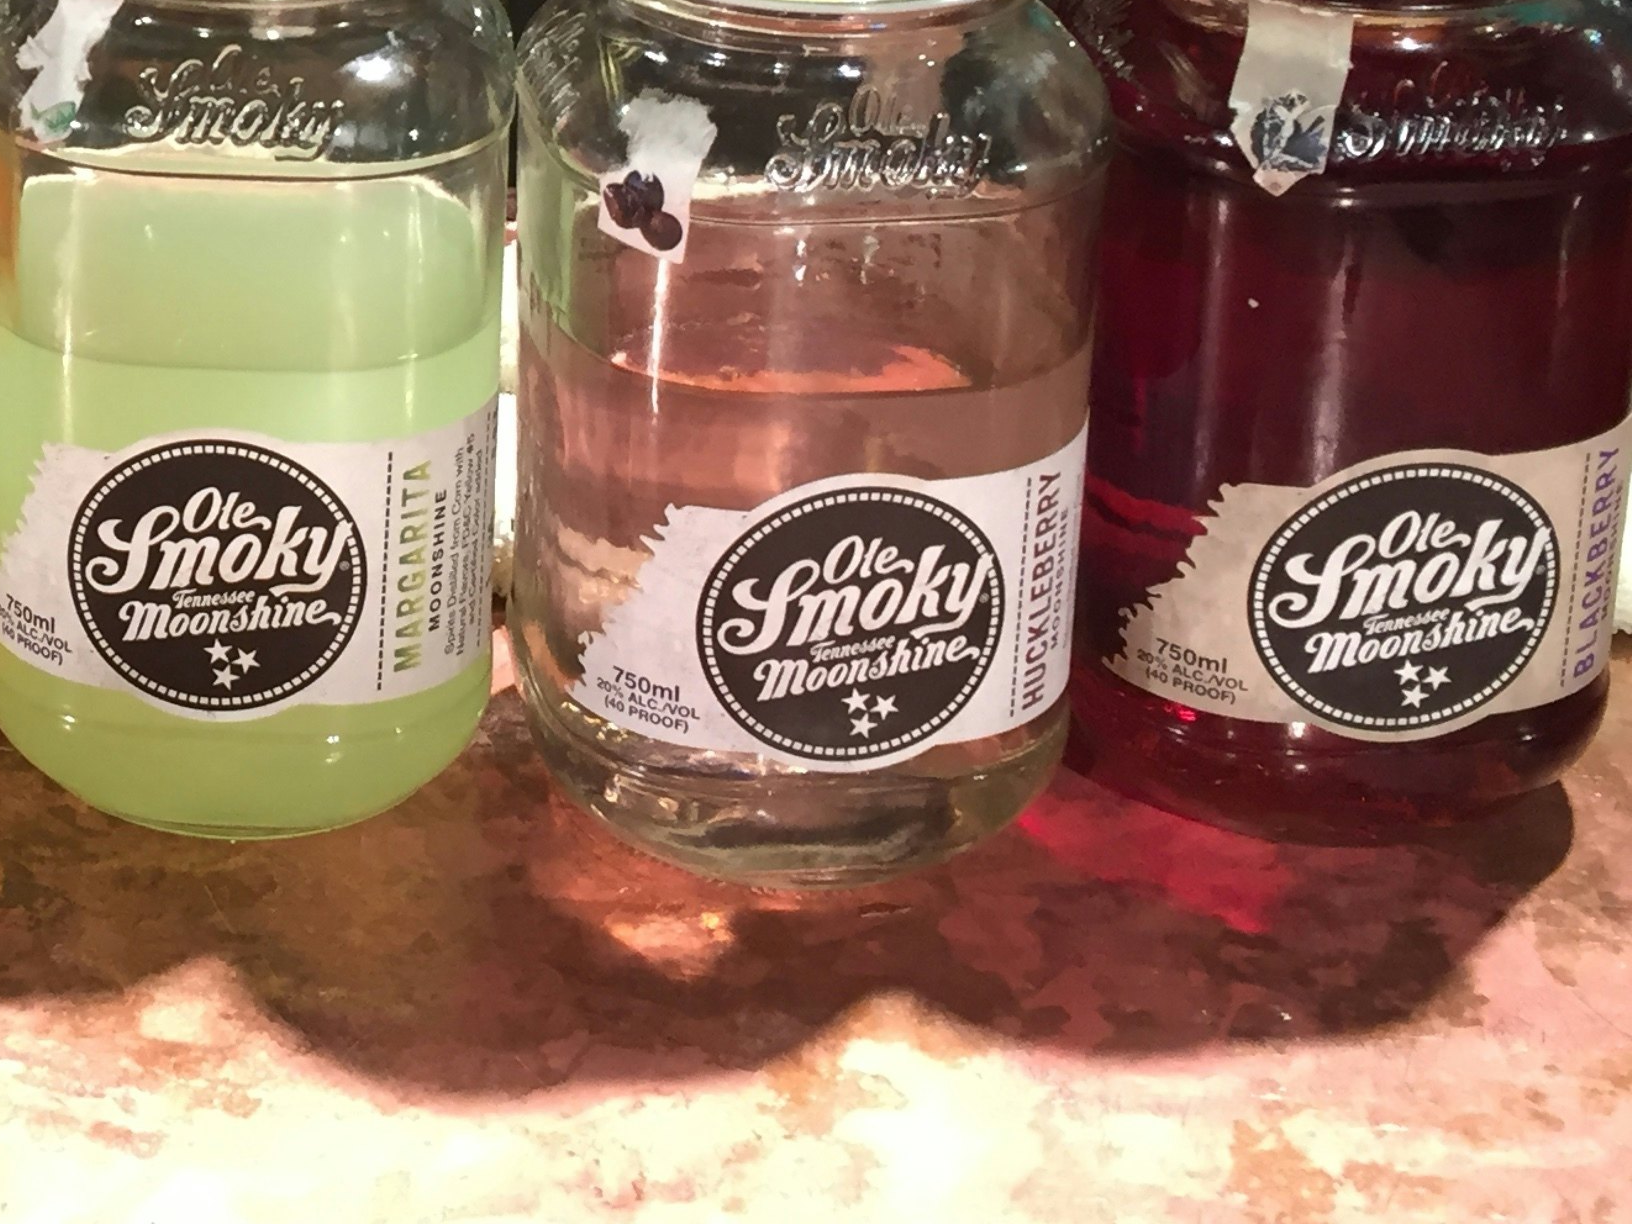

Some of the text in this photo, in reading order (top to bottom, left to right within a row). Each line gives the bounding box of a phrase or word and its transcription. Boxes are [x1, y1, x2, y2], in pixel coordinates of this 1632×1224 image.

[124, 58, 345, 162] Smoky
[765, 102, 992, 200] Smoky
[183, 486, 273, 534] Ole
[1377, 509, 1473, 559] Ole
[84, 505, 354, 598] Smoky
[393, 459, 432, 674] MARGARITA
[428, 488, 448, 633] MOONSHINE
[443, 445, 465, 656] Spirits Distilled from Corn with
[822, 534, 916, 585] Ole
[1268, 518, 1555, 630] Smoky
[1574, 446, 1620, 680] BLACKBERRY
[6, 592, 56, 634] 750ml
[171, 588, 256, 609] Tennessee
[716, 544, 996, 656] Smoky
[1021, 470, 1062, 711] HUCKLEBERRY
[118, 594, 343, 643] Moonshine
[1304, 606, 1535, 675] Moonshine
[1362, 606, 1450, 636] Tennessee
[17, 632, 64, 666] PROOF)
[753, 635, 981, 703] Moonshine
[809, 635, 897, 664] Tennessee
[1136, 648, 1168, 671] 20%
[1155, 637, 1228, 675] 750ml
[596, 676, 624, 698] 20%
[612, 664, 680, 703] 750ml
[1172, 677, 1237, 705] PROOF)
[604, 694, 690, 735] (40 PROOF)
